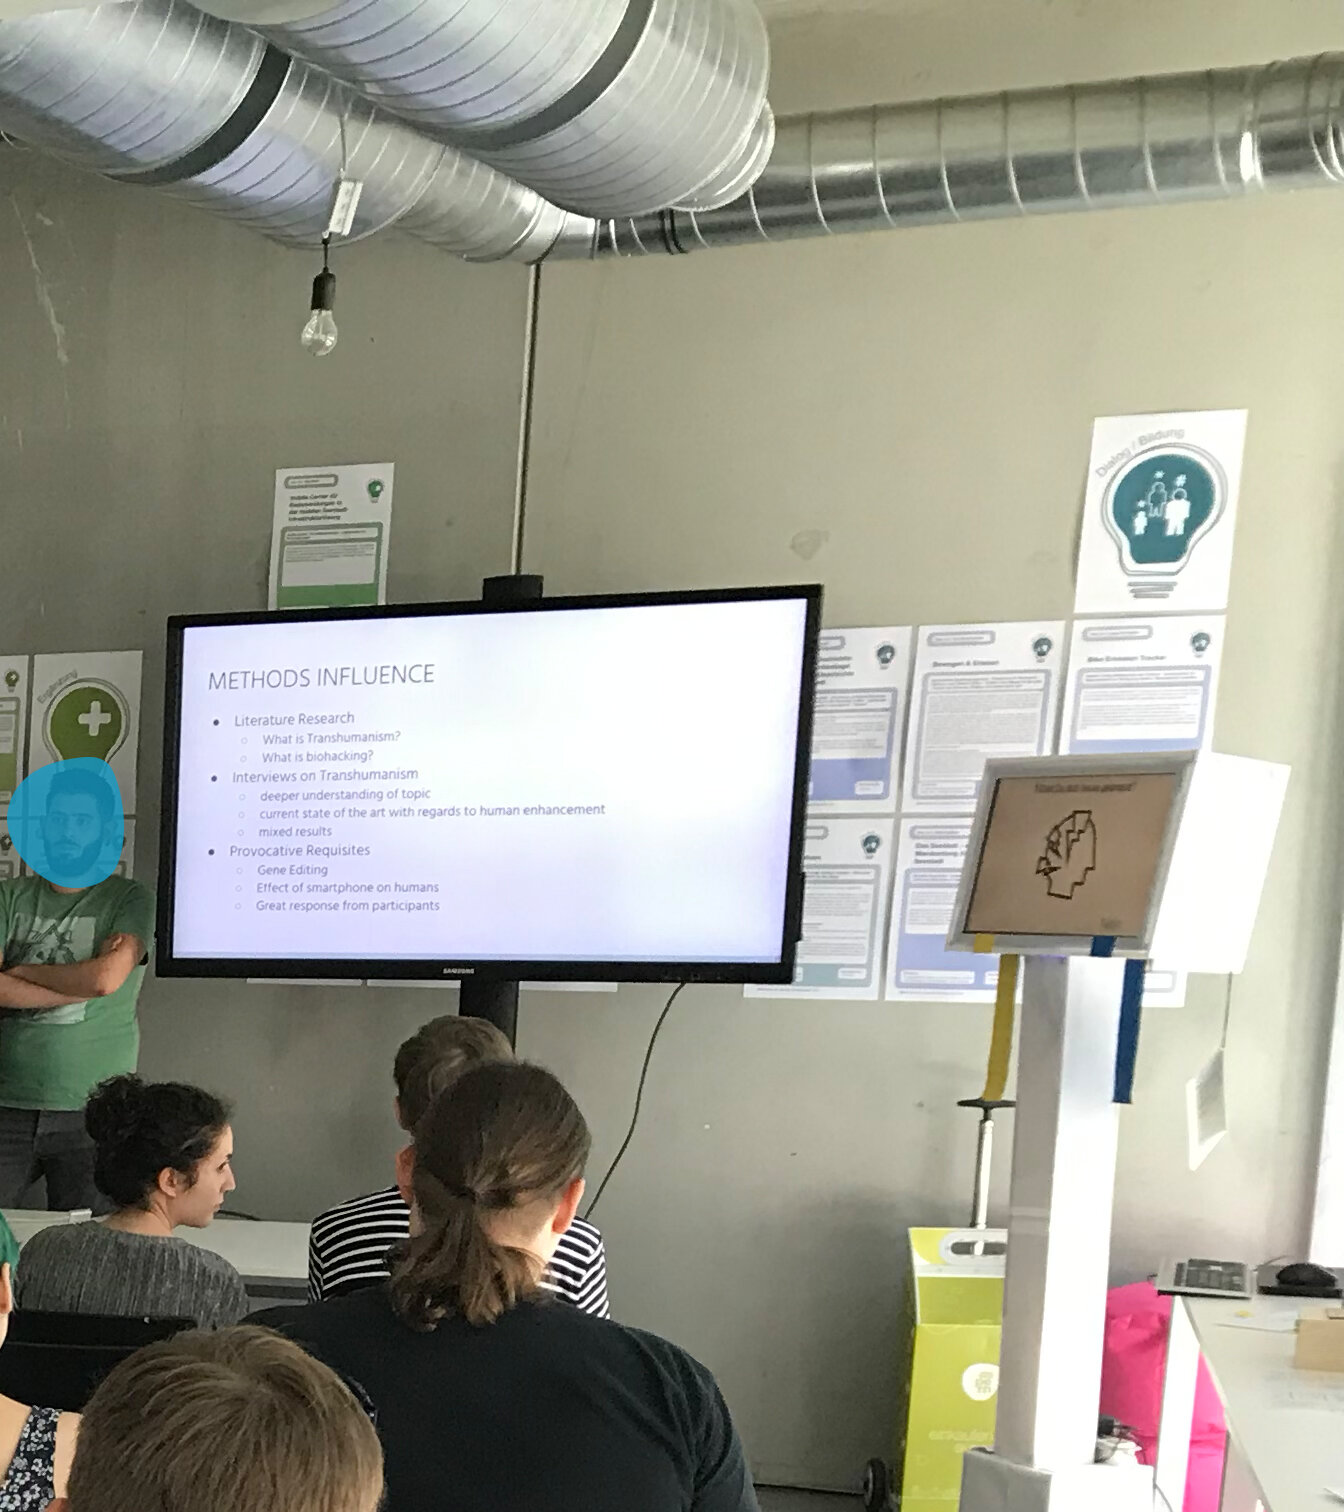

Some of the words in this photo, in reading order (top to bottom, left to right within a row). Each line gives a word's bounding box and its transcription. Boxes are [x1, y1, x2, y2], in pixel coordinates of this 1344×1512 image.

[1095, 448, 1131, 477] Dialog
[1138, 429, 1185, 446] Bildung
[208, 669, 311, 690] METHODS
[317, 664, 435, 686] INFLUENCE
[234, 714, 295, 727] Literature
[298, 711, 355, 725] Research
[262, 733, 293, 745] What
[296, 733, 304, 744] is
[307, 731, 401, 744] Transhumanism?
[262, 752, 292, 763] What
[295, 752, 303, 762] is
[306, 750, 373, 764] biohacking?
[232, 771, 297, 783] Interviews
[300, 772, 316, 781] on
[320, 768, 419, 781] Transhumanism
[260, 790, 300, 803] deeper
[302, 789, 383, 801] understanding
[386, 788, 399, 799] of
[401, 788, 431, 800] topic
[260, 808, 299, 819] current
[302, 807, 331, 819] state
[333, 806, 346, 818] of
[348, 806, 368, 817] the
[370, 807, 386, 817] art
[388, 805, 415, 817] with
[417, 804, 461, 819] regards
[463, 806, 477, 816] to
[480, 804, 520, 816] human
[523, 804, 605, 815] enhancement
[259, 825, 293, 837] mixed
[295, 825, 332, 837] results
[230, 845, 303, 857] Provocative
[306, 844, 371, 858] Requisites
[257, 865, 287, 876] Gene
[289, 864, 329, 878] Editing
[256, 882, 289, 894] Effect
[291, 881, 304, 893] of
[306, 882, 373, 895] smartphone
[376, 883, 391, 893] on
[394, 881, 440, 892] humans
[256, 900, 286, 912] Great
[289, 901, 340, 913] response
[342, 899, 369, 911] from
[372, 899, 440, 913] participants
